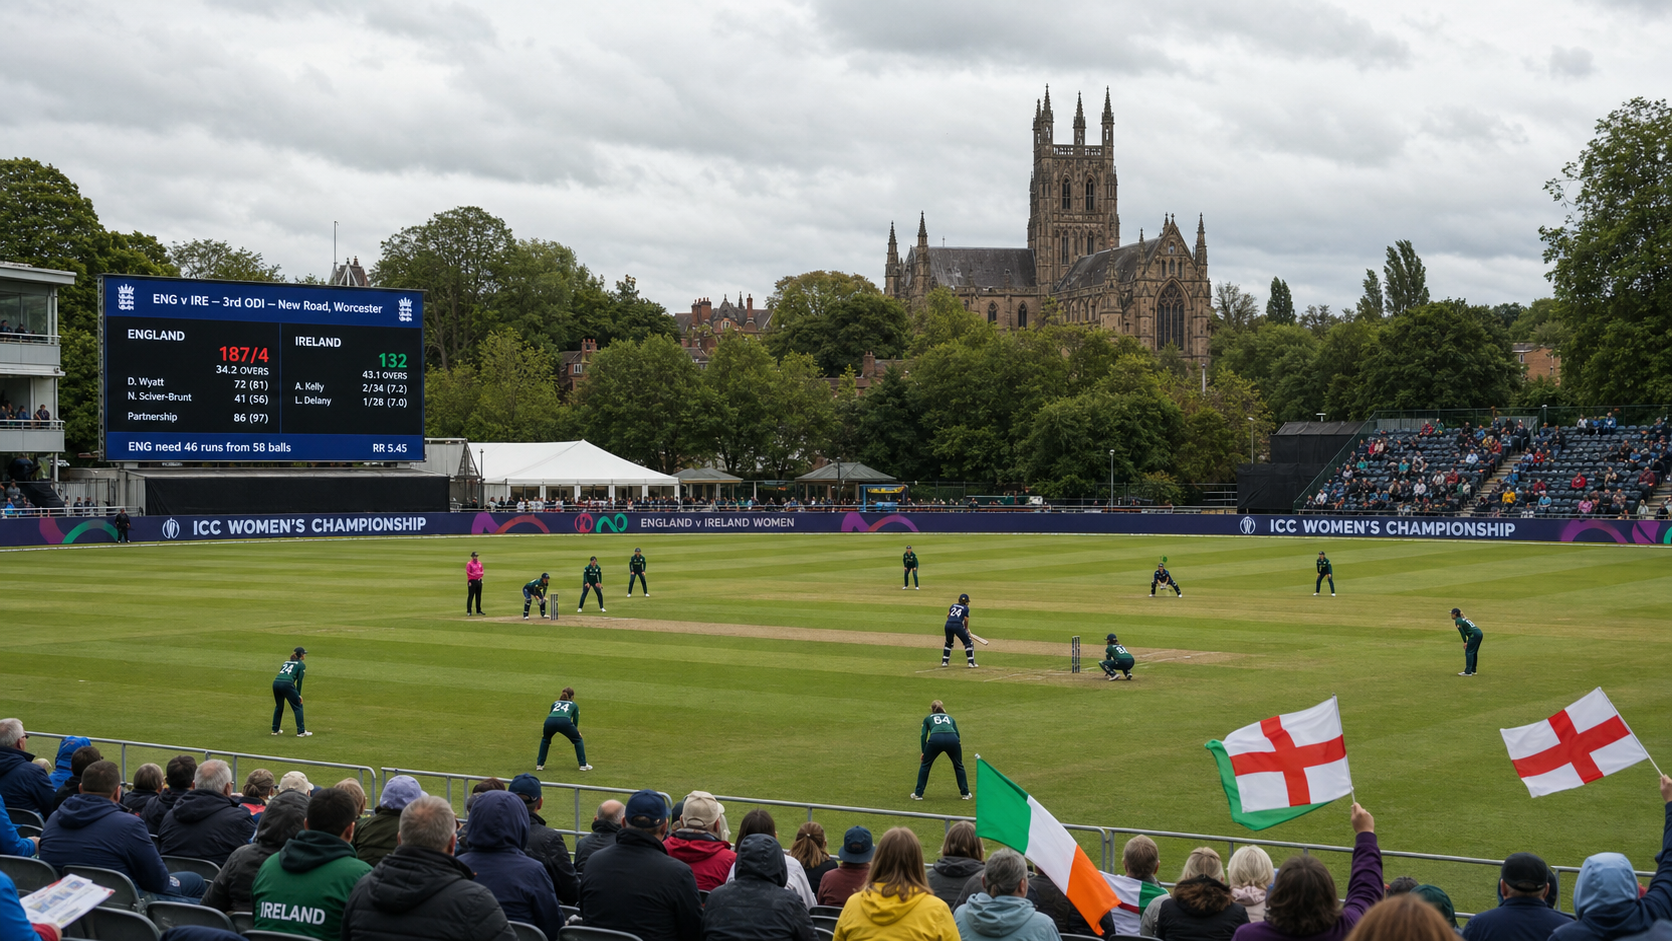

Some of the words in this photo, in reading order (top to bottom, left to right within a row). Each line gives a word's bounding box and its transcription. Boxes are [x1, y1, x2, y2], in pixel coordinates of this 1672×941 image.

[153, 293, 177, 305] ENG
[181, 296, 187, 305] v
[190, 294, 209, 306] IRE
[222, 296, 242, 307] 3rd
[244, 297, 265, 308] ODI
[278, 299, 301, 310] New
[303, 300, 331, 313] Road,
[333, 301, 382, 313] Worcester
[128, 329, 185, 341] ENGLAND
[295, 336, 341, 347] IRELAND
[219, 346, 269, 363] 187/4
[379, 353, 407, 367] 132
[216, 365, 237, 375] 34.2
[240, 366, 269, 376] OVERS
[362, 370, 380, 379] 43.1
[382, 371, 408, 380] OVERS
[128, 377, 137, 386] D.
[138, 377, 164, 388] Wyatt
[234, 380, 246, 389] 72
[249, 380, 269, 391] (81)
[295, 382, 303, 390] A.
[305, 382, 324, 392] Kelly
[362, 383, 383, 393] 2/34
[387, 384, 408, 394] (7.2)
[128, 392, 137, 401] N.
[139, 392, 192, 402] Sciver-Brunt
[234, 395, 246, 403] 41
[249, 395, 269, 406] (56)
[295, 396, 302, 404] L.
[304, 396, 331, 407] Delany
[362, 398, 384, 407] 1/28
[387, 398, 408, 408] (7.0)
[128, 412, 177, 423] Partnership
[233, 414, 246, 422] 86
[249, 413, 269, 424] (97)
[128, 441, 152, 452] ENG
[155, 442, 181, 452] need
[184, 442, 198, 452] 46
[201, 444, 224, 452] runs
[226, 442, 250, 452] from
[252, 443, 266, 452] 58
[268, 442, 291, 453] balls
[373, 444, 386, 453] RR
[387, 444, 408, 453] 5.45
[193, 520, 221, 535] ICC
[228, 519, 305, 535] WOMEN'S
[311, 517, 427, 533] CHAMPIONSHIP
[640, 518, 691, 528] ENGLAND
[704, 518, 749, 528] IRELAND
[752, 518, 795, 528] WOMEN
[1270, 519, 1297, 533] ICC
[1303, 519, 1380, 535] WOMEN'S
[1385, 521, 1515, 537] CHAMPIONSHIP
[950, 608, 963, 618] 24
[280, 664, 294, 675] 24
[552, 702, 570, 712] 24
[260, 902, 326, 925] IRELAND
